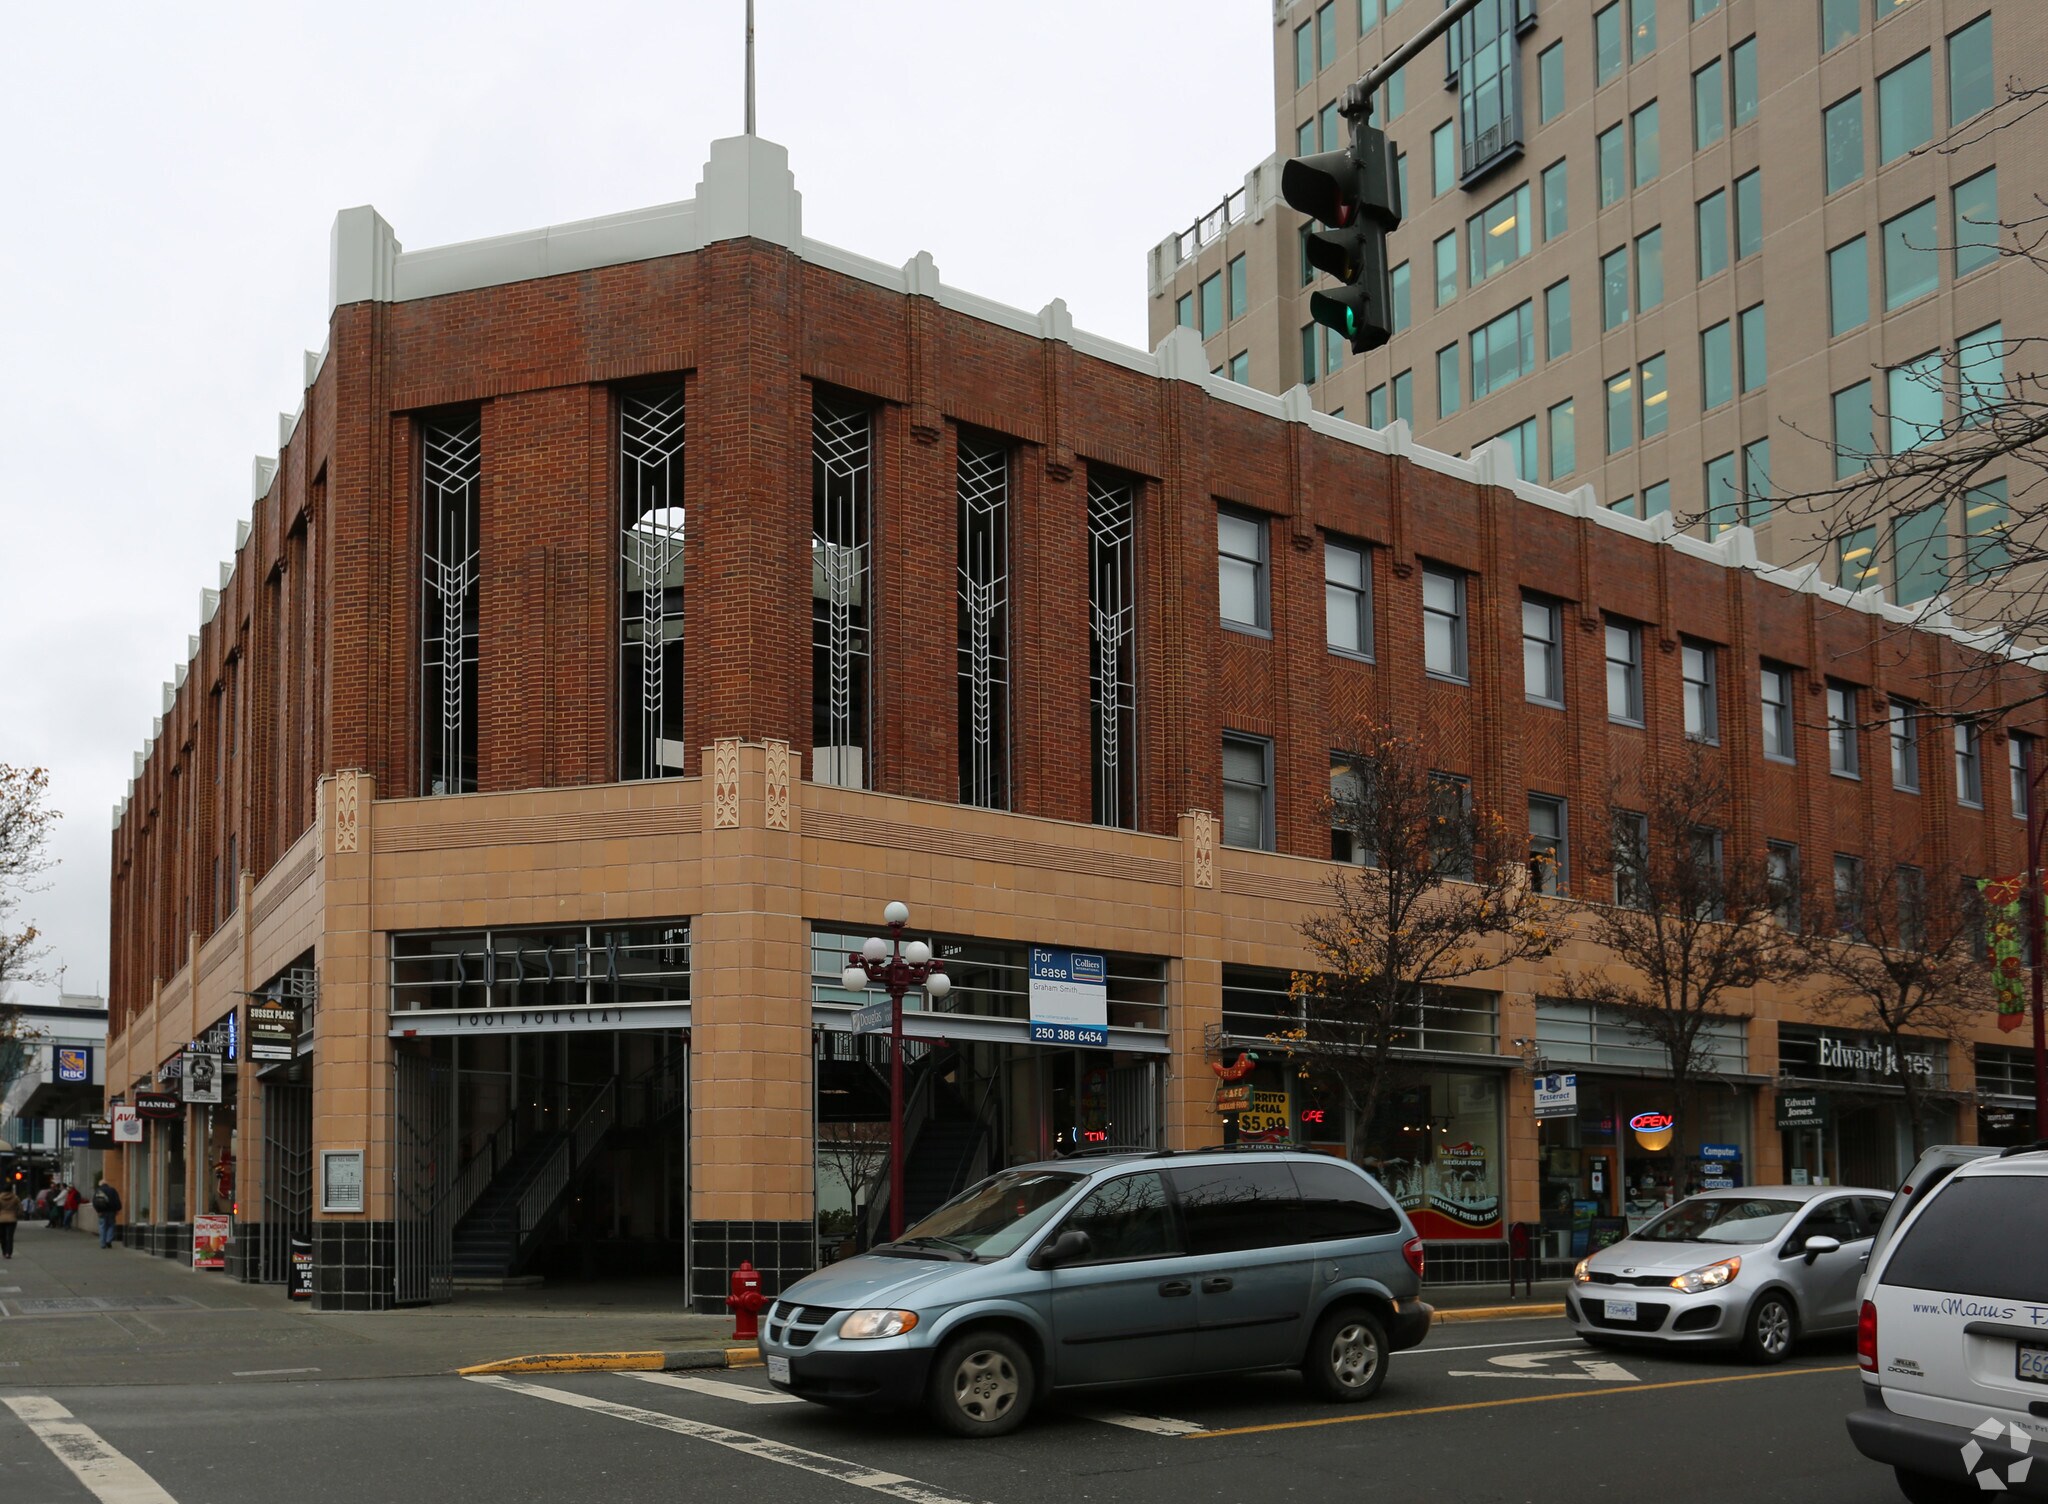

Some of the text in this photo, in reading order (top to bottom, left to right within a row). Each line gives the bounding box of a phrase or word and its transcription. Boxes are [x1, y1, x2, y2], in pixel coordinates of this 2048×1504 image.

[1034, 948, 1053, 963] For
[457, 943, 619, 989] SUSSEX
[1074, 958, 1100, 969] Colliers
[1034, 963, 1067, 979] Lease
[1033, 982, 1078, 993] Graham Smith
[250, 1008, 295, 1020] SUSSEX PLACE
[457, 1010, 623, 1026] 1001 DOUGLAS
[860, 1010, 882, 1027] Douglas
[1035, 1027, 1103, 1043] 250 388 6454
[1818, 1037, 1883, 1071] Edward
[62, 1070, 84, 1078] RBC
[1223, 1087, 1244, 1099] CAFE
[1539, 1092, 1570, 1102] Tesseract
[1785, 1097, 1816, 1107] Edward
[1788, 1107, 1814, 1117] Jones
[1632, 1114, 1673, 1128] OPEN
[1778, 1117, 1823, 1127] INVESTMENTS
[1703, 1146, 1736, 1157] Computer
[1704, 1164, 1723, 1174] sales
[1704, 1180, 1734, 1190] services
[1429, 1196, 1459, 1216] HEALTHY,
[1458, 1210, 1478, 1222] FRESH
[1484, 1208, 1499, 1221] FAST
[1887, 1366, 1925, 1377] DODGE
